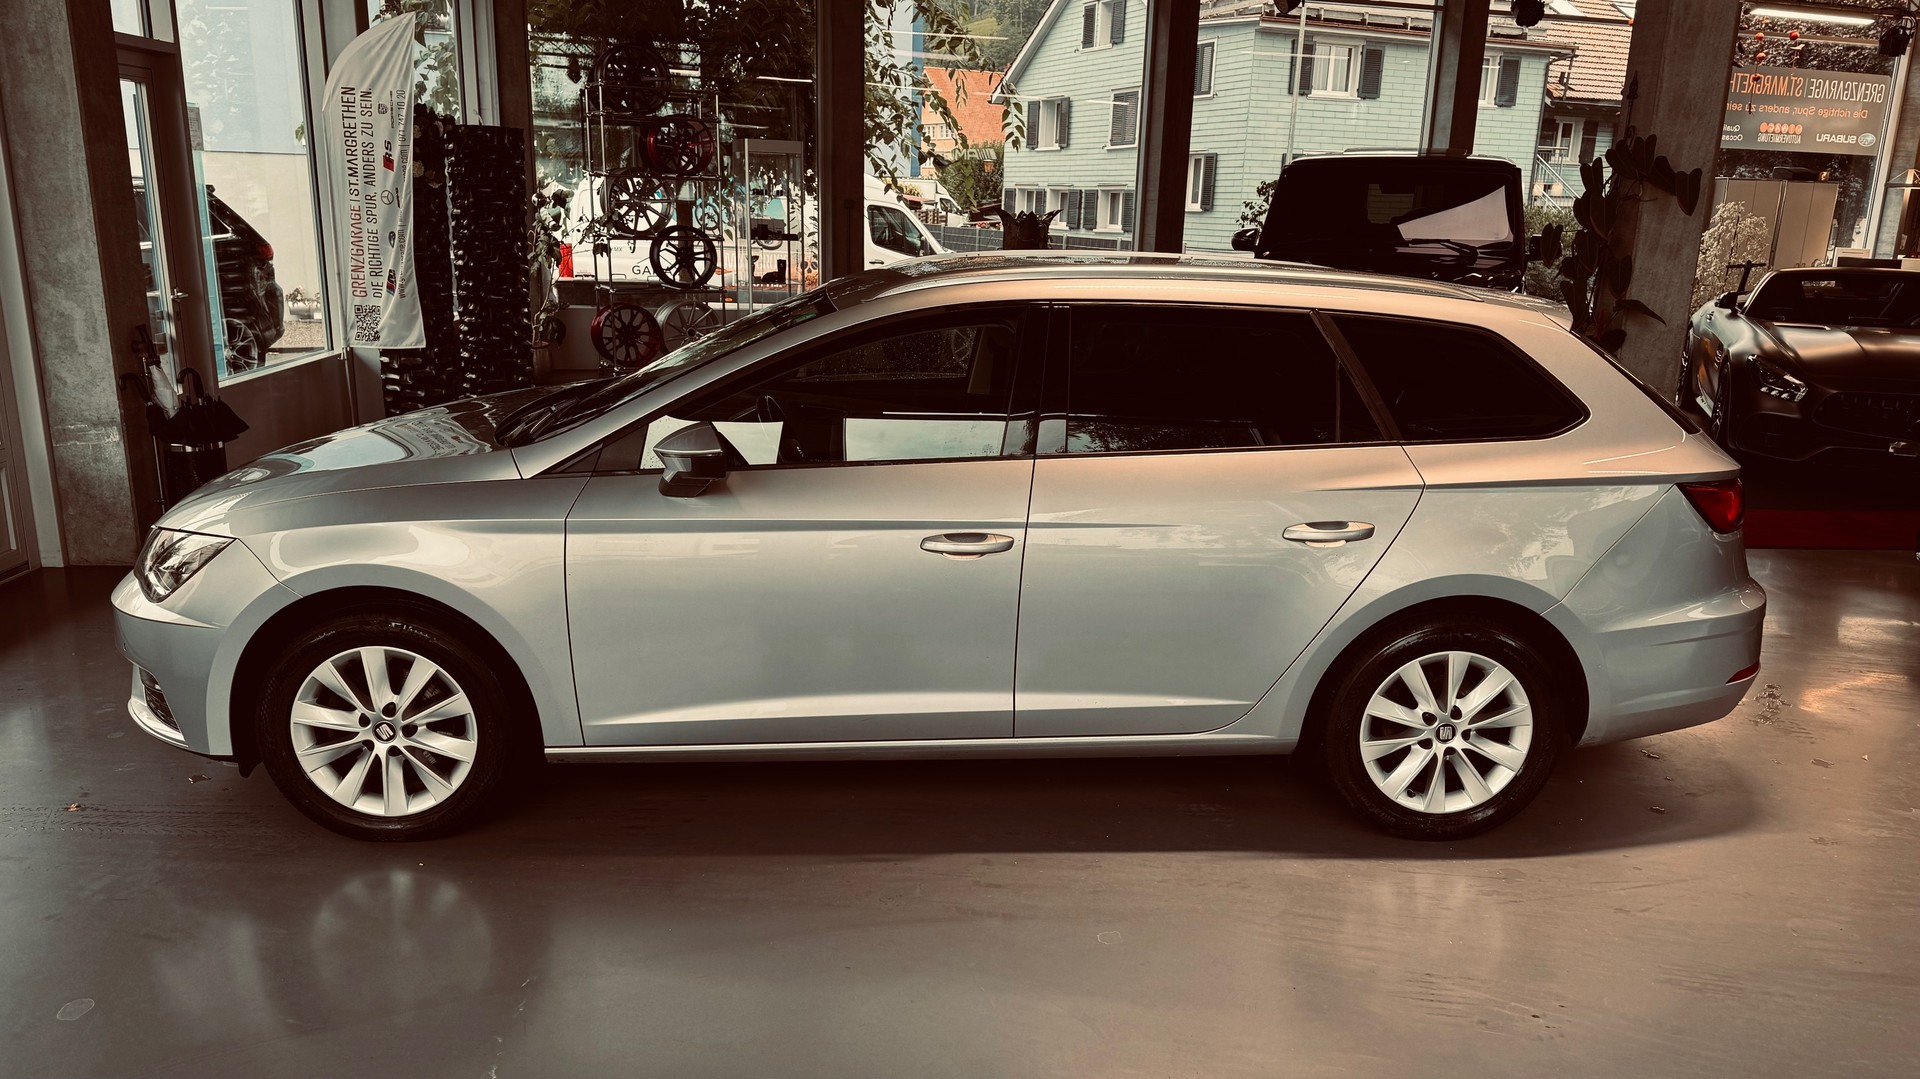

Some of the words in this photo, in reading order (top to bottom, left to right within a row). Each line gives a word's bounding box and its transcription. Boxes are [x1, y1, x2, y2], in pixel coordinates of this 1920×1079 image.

[360, 88, 373, 117] SEIN.
[341, 86, 360, 197] ST.MARGRETHEN
[361, 122, 374, 138] ZU
[361, 141, 376, 187] ANDERS
[365, 192, 378, 224] SPUR,
[350, 204, 368, 298] GRENZGARAGE
[367, 228, 384, 277] RICHTIGE
[371, 281, 384, 299] DIE
